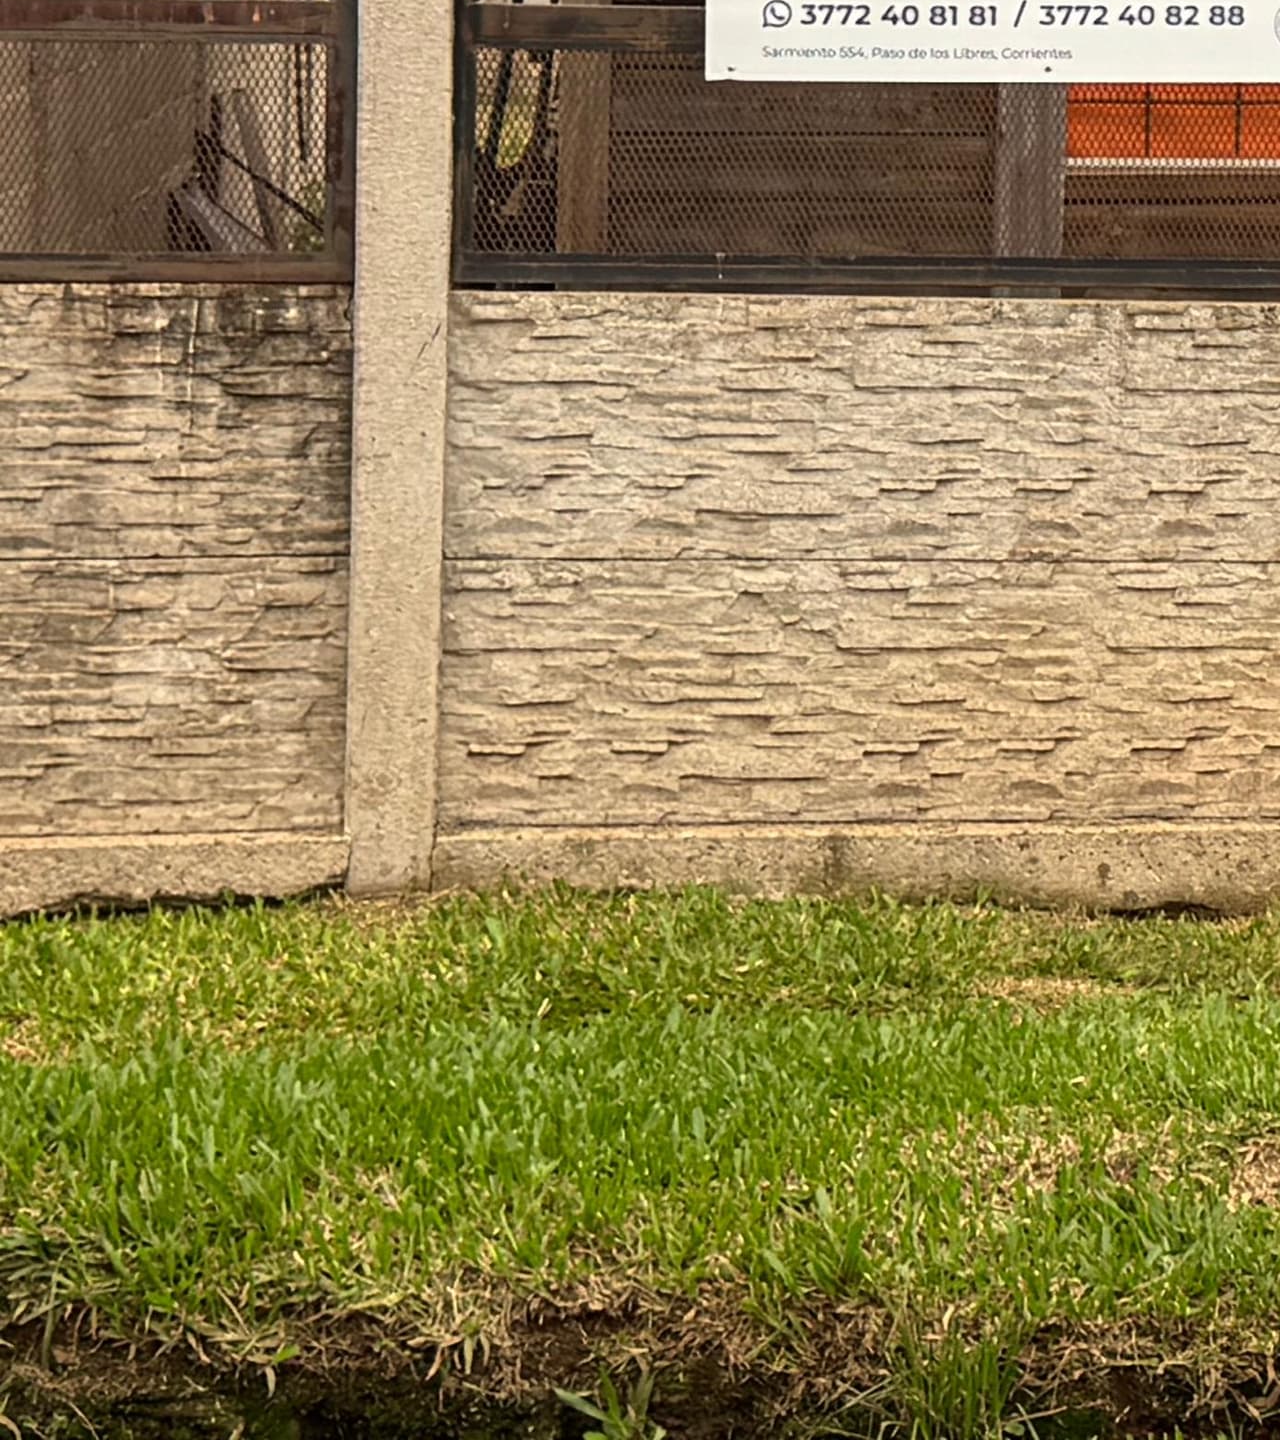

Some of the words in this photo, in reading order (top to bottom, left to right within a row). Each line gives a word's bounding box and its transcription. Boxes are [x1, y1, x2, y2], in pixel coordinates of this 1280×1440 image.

[800, 4, 871, 26] 3772
[880, 4, 920, 26] 40
[928, 5, 958, 26] 81
[968, 5, 997, 27] 81
[1013, 0, 1027, 28] /
[1038, 4, 1109, 26] 3772
[1118, 4, 1155, 26] 40
[1164, 5, 1200, 26] 82
[1208, 5, 1245, 26] 88
[871, 46, 906, 60] Paso
[908, 47, 928, 60] de
[930, 47, 950, 60] los
[1000, 47, 1073, 61] Corrientes
